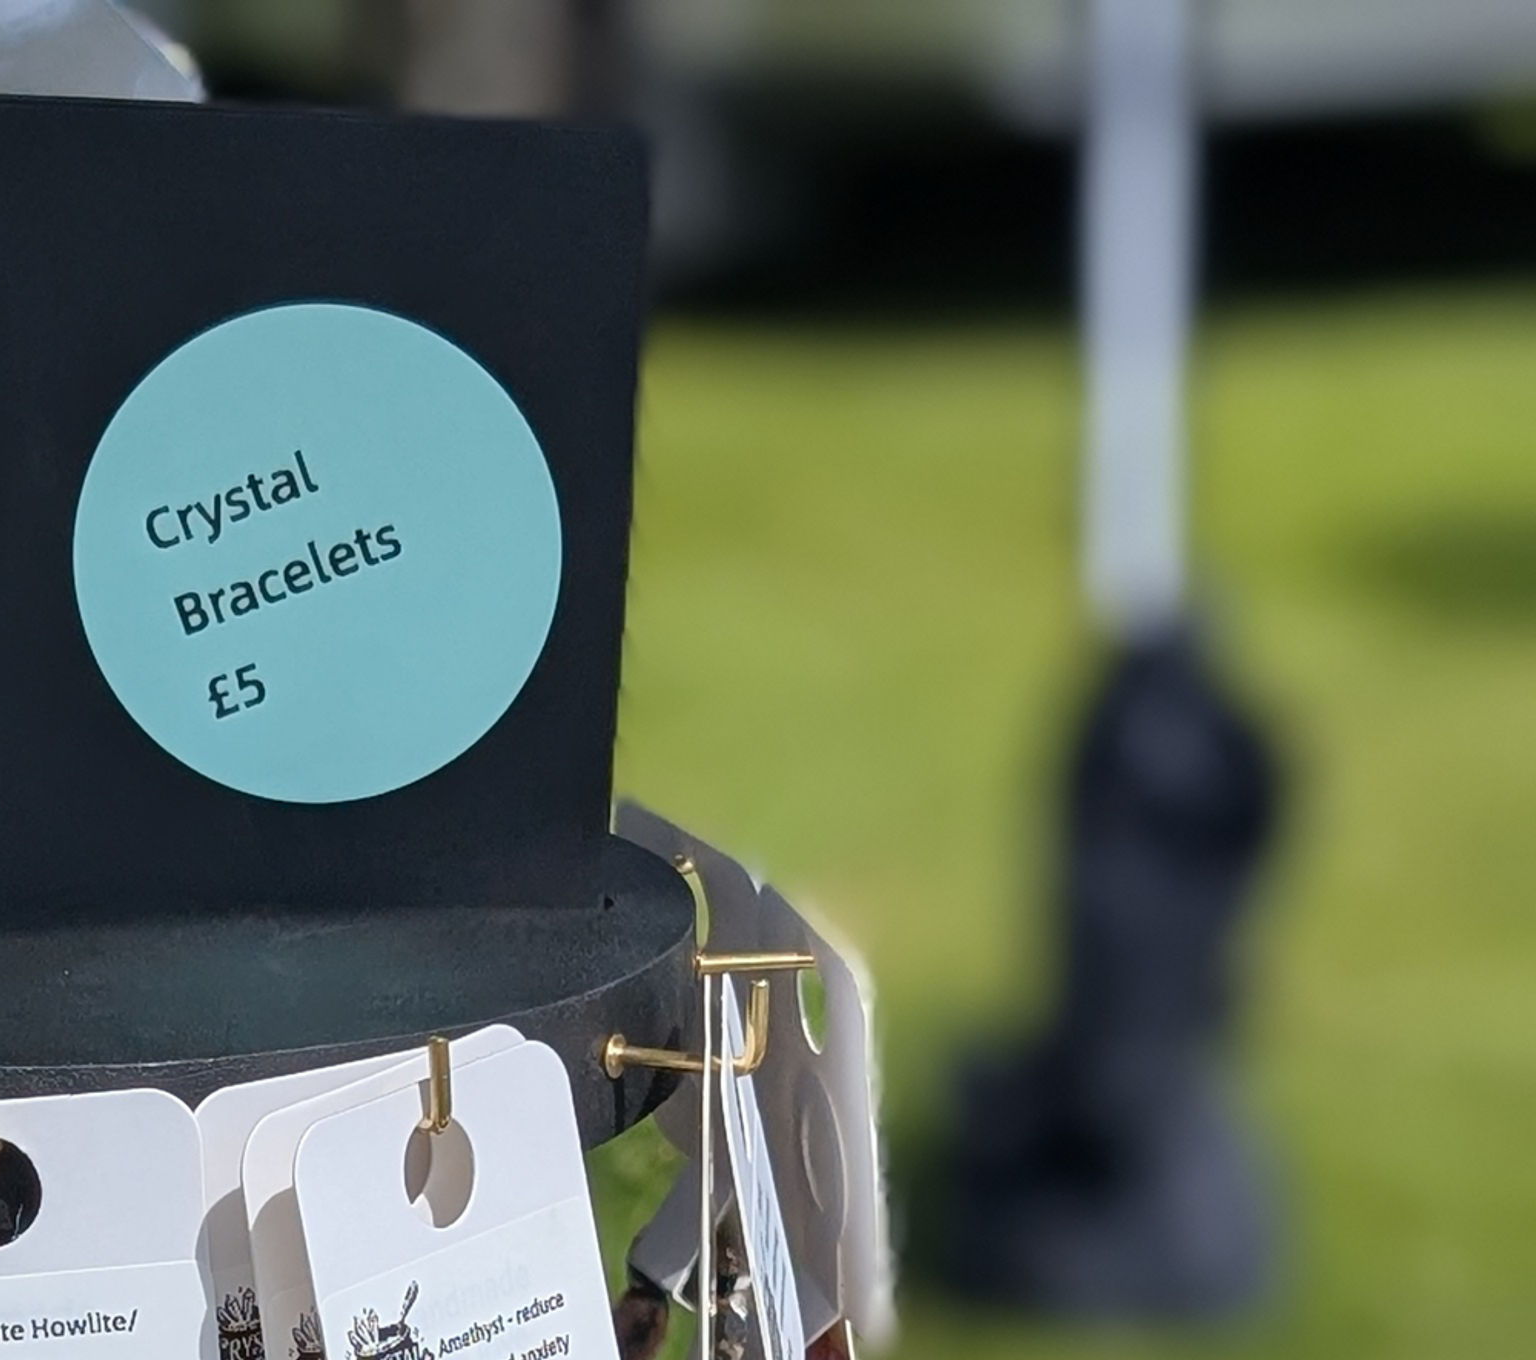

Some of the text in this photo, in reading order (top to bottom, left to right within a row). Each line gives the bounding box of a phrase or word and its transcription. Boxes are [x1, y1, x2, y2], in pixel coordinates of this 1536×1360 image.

[146, 449, 320, 549] Crystal
[173, 524, 402, 636] Bracelets
[208, 662, 267, 719] £5
[438, 1317, 505, 1359] Amethyst
[516, 1292, 566, 1327] reduce
